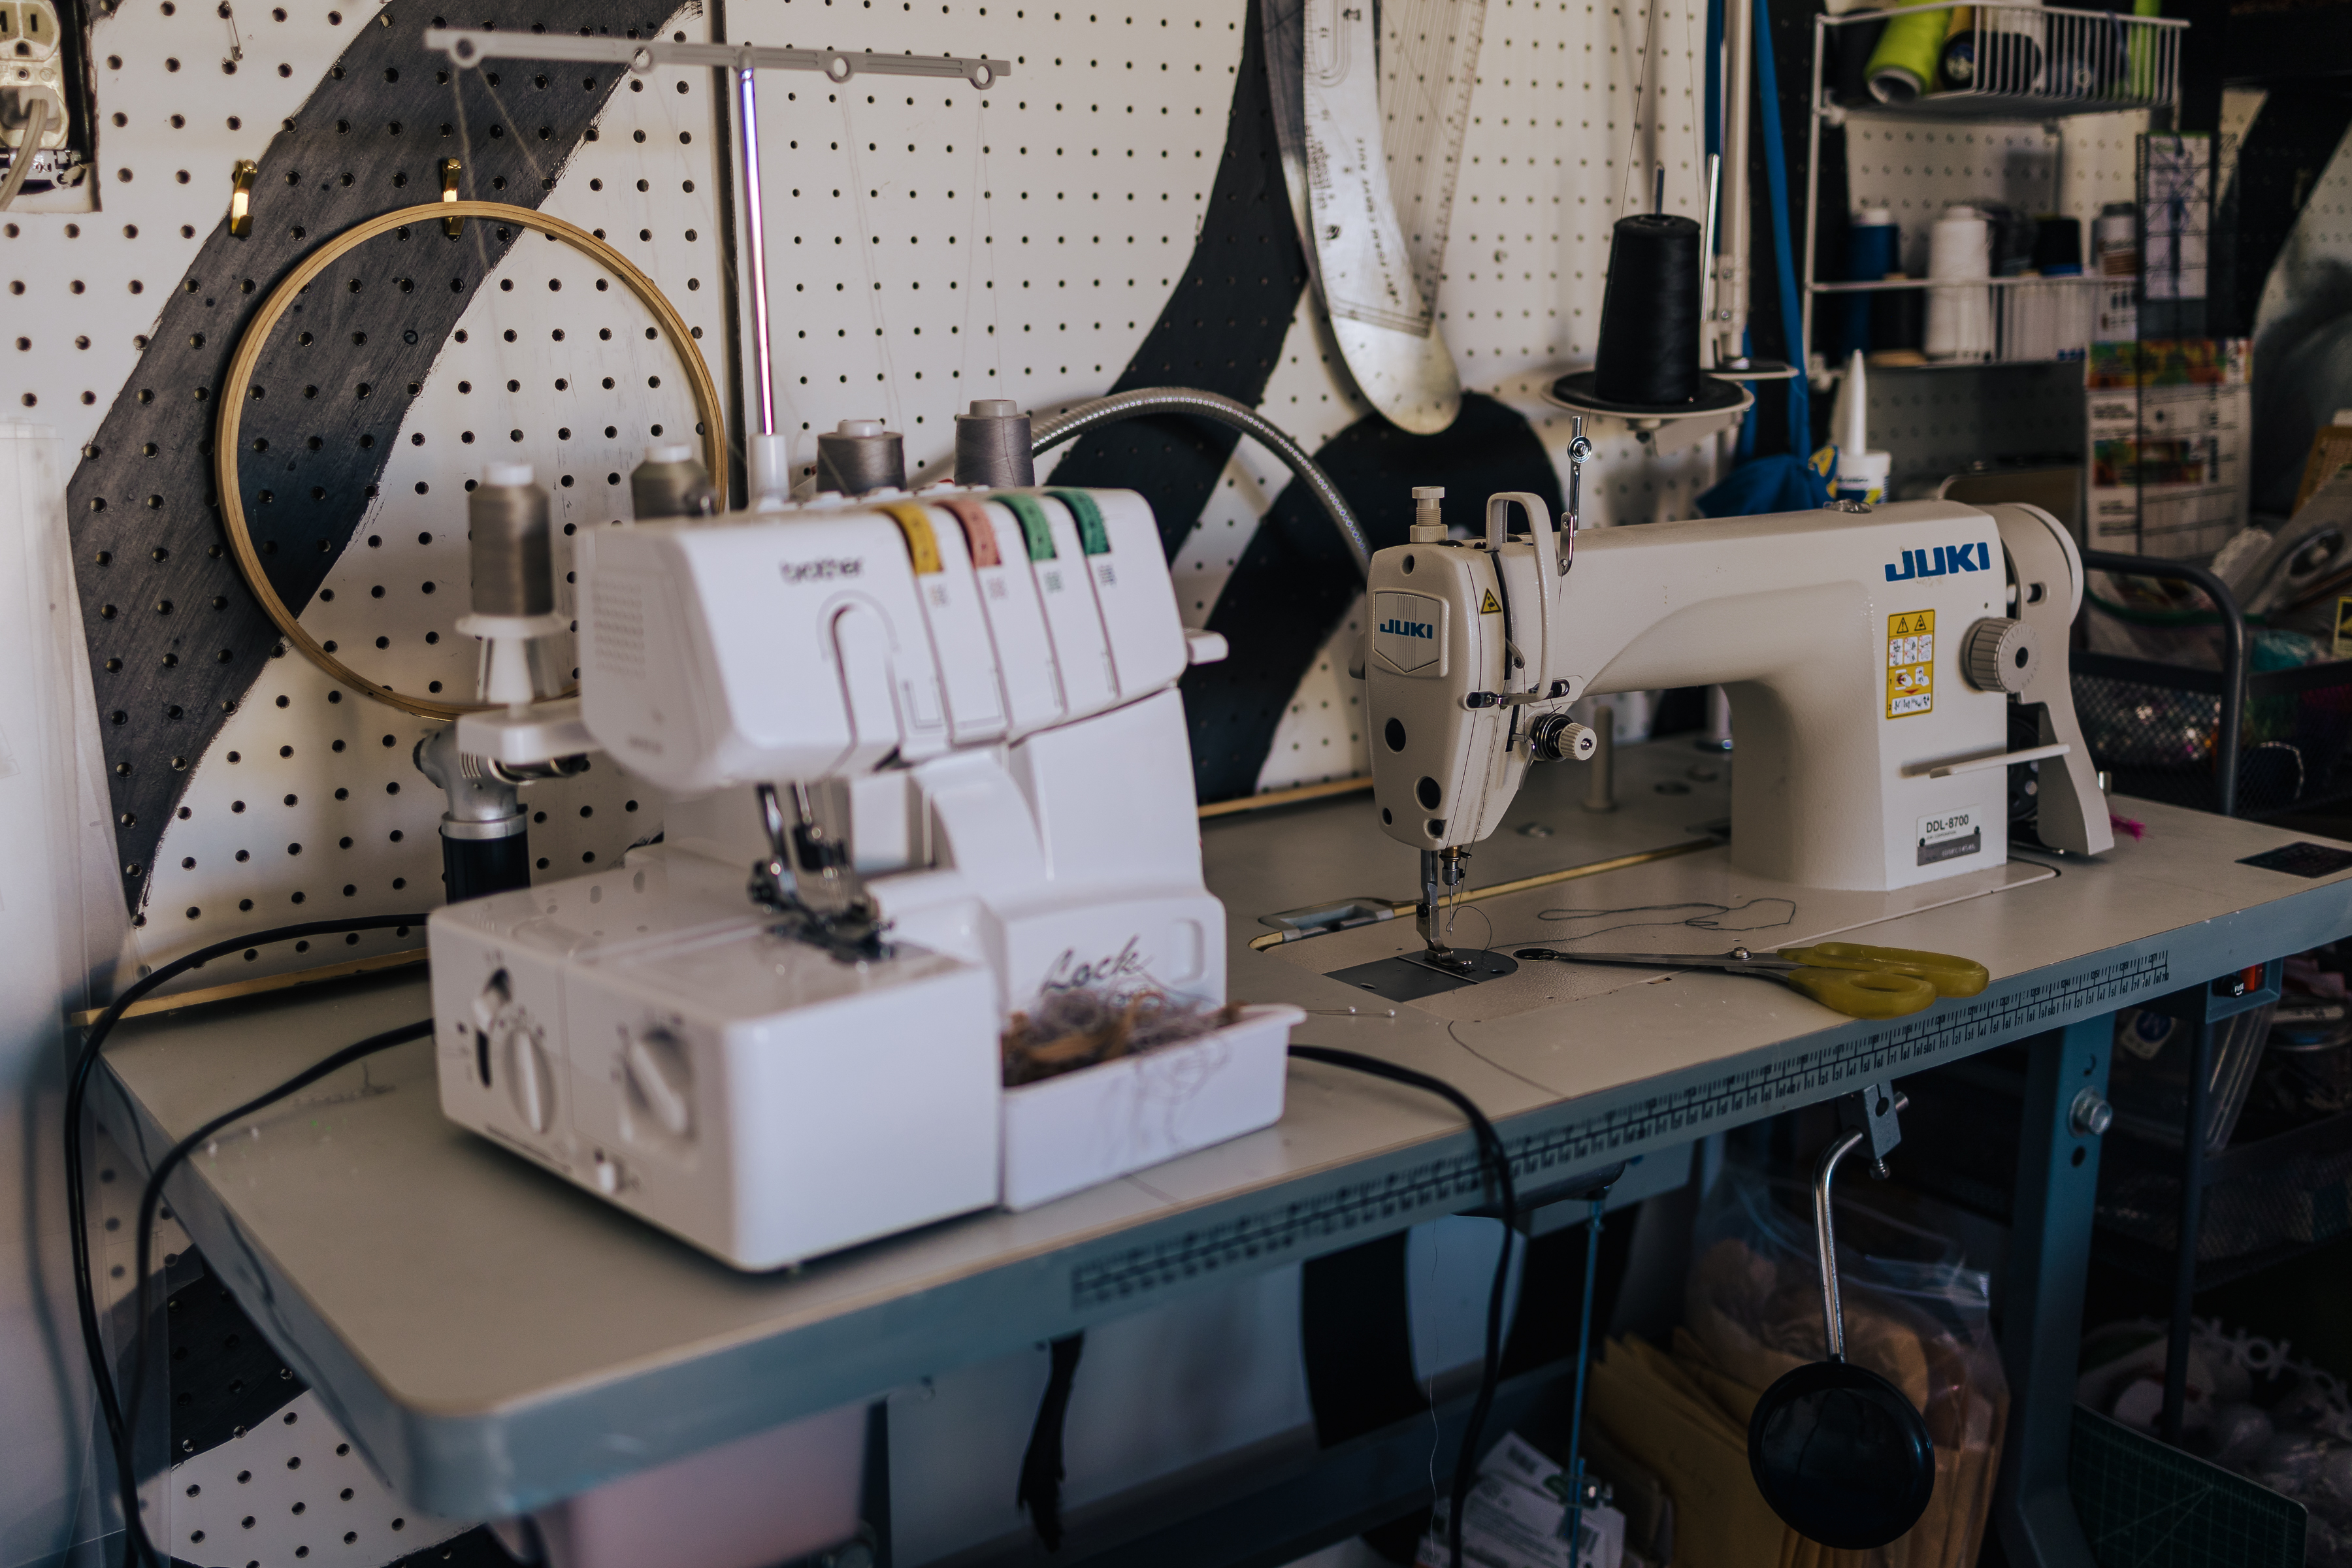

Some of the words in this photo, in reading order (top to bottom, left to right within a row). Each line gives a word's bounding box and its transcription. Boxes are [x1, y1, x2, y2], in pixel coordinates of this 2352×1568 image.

[1885, 542, 1991, 581] JUKI
[1380, 619, 1433, 640] JUKI
[1926, 814, 1969, 833] DDL-8700
